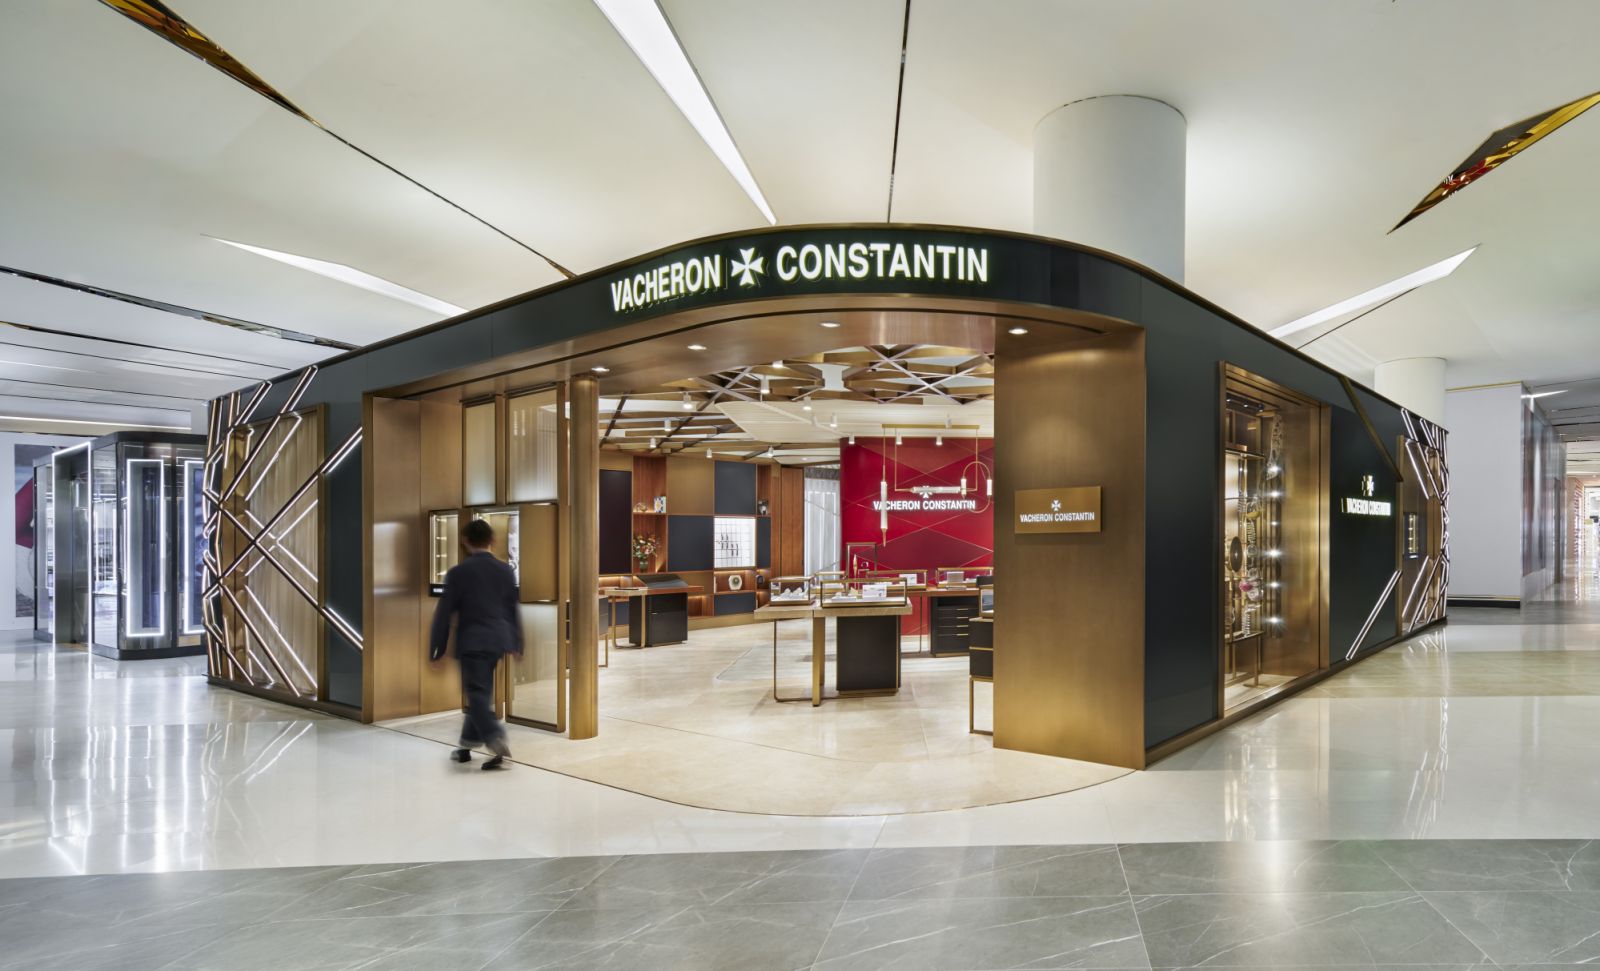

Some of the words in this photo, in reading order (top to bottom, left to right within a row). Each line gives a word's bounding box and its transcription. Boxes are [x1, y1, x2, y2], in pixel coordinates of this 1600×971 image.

[611, 254, 721, 312] VACHERON
[776, 243, 988, 282] CONSTANTIN
[922, 500, 976, 510] CONSTANTIN
[1020, 513, 1053, 523] VACHERON
[1054, 511, 1095, 522] CONSTANTIN
